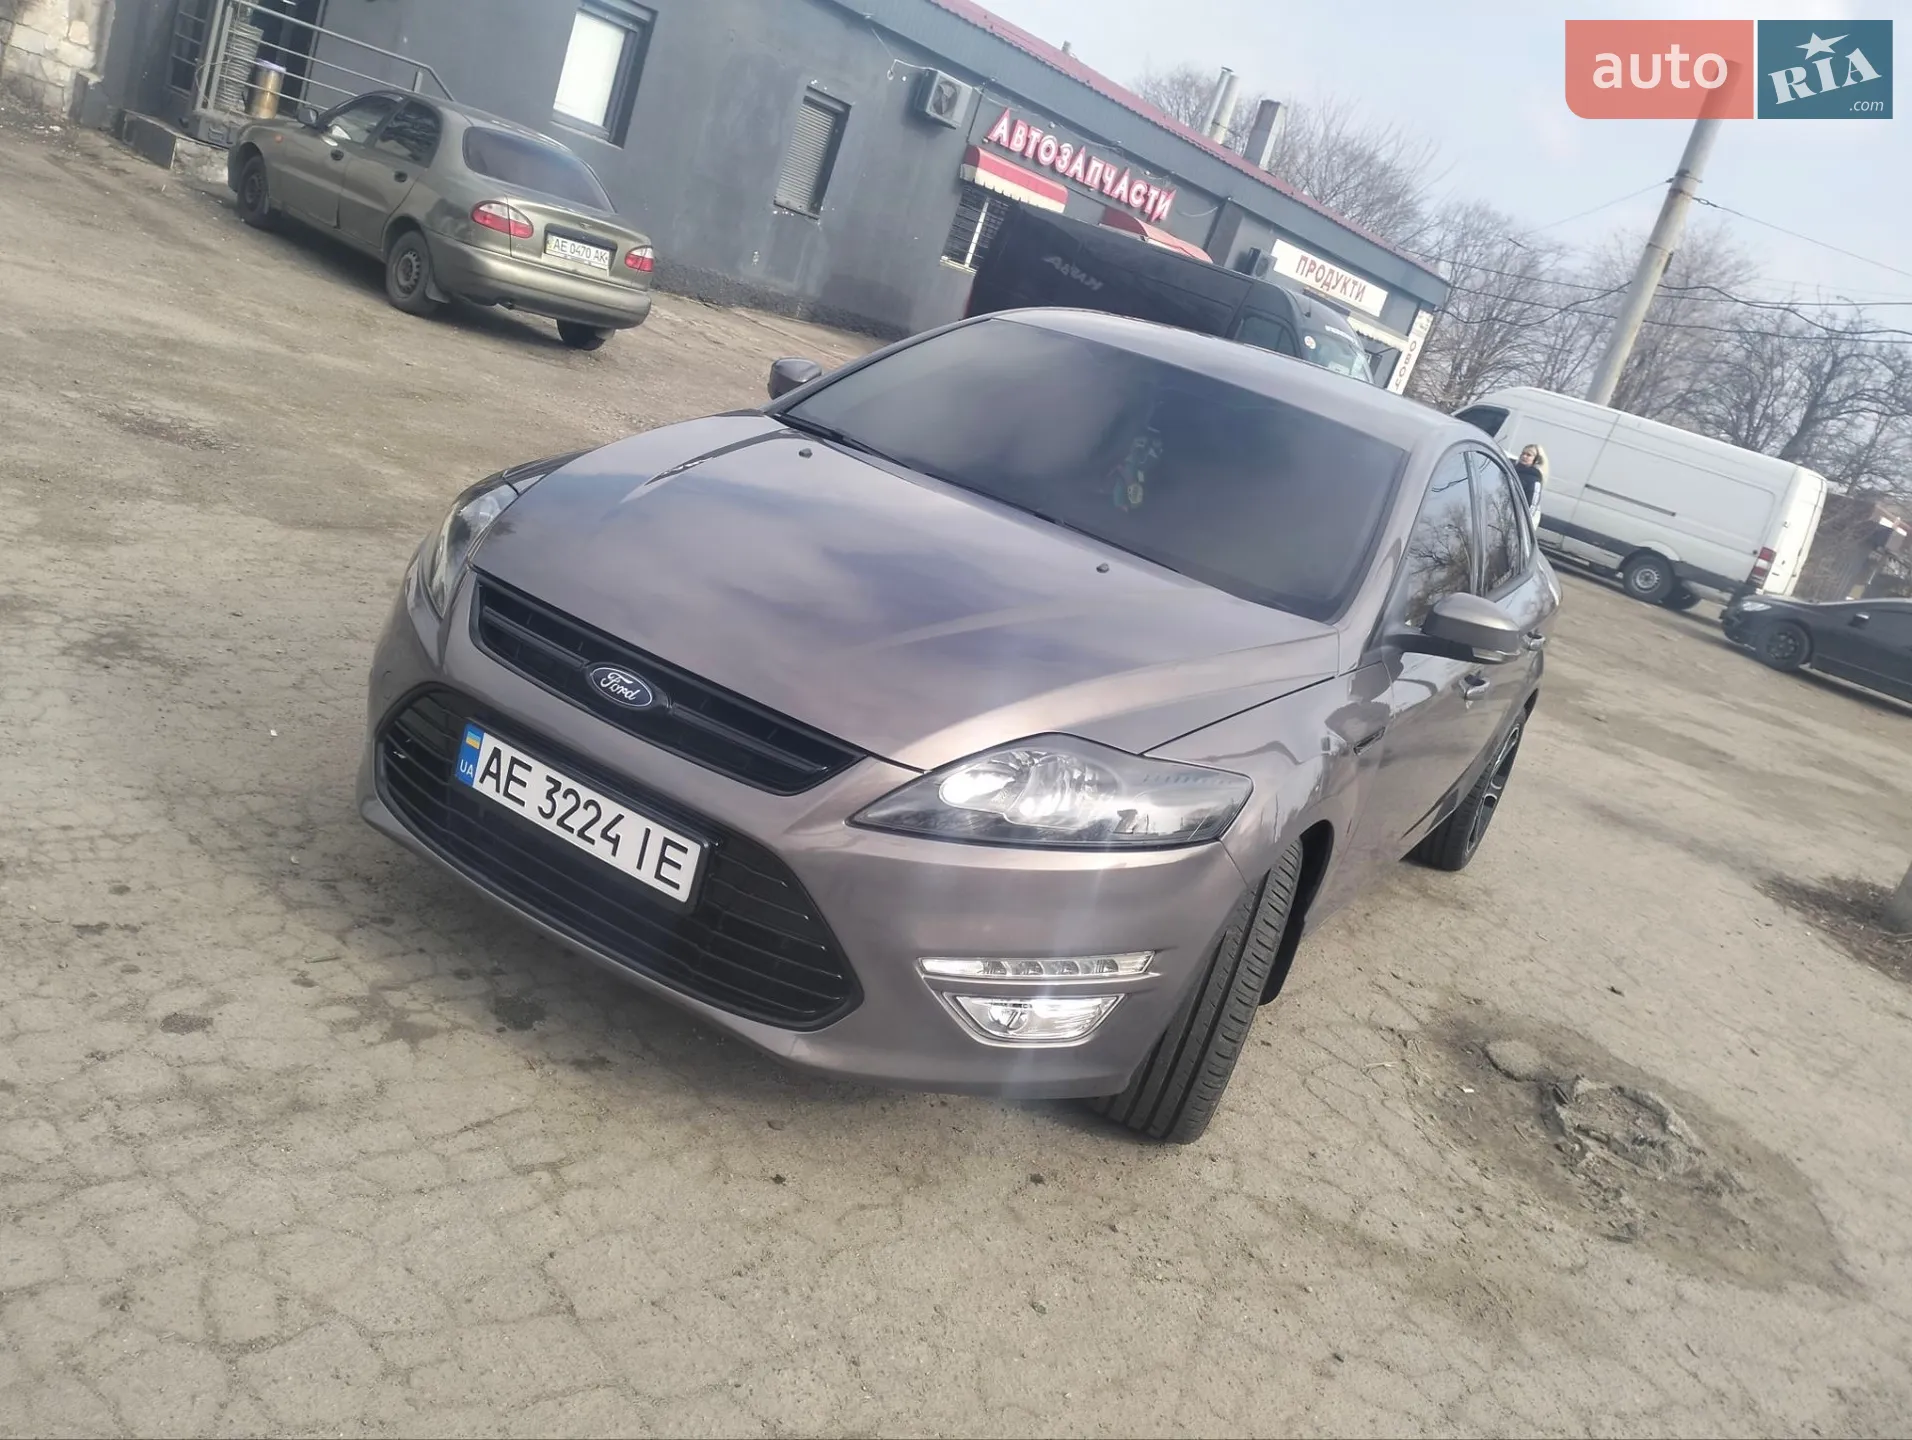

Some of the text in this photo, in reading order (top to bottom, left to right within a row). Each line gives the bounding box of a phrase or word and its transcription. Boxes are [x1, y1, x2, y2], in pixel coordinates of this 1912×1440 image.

[987, 107, 1177, 223] АВТОЗАПЧАСТИ
[553, 238, 606, 263] AE 0470 AK
[1295, 254, 1367, 303] ПРОДУКТИ
[600, 672, 641, 701] Ford
[459, 759, 475, 779] UA
[478, 746, 689, 891] AE 3224 IE
